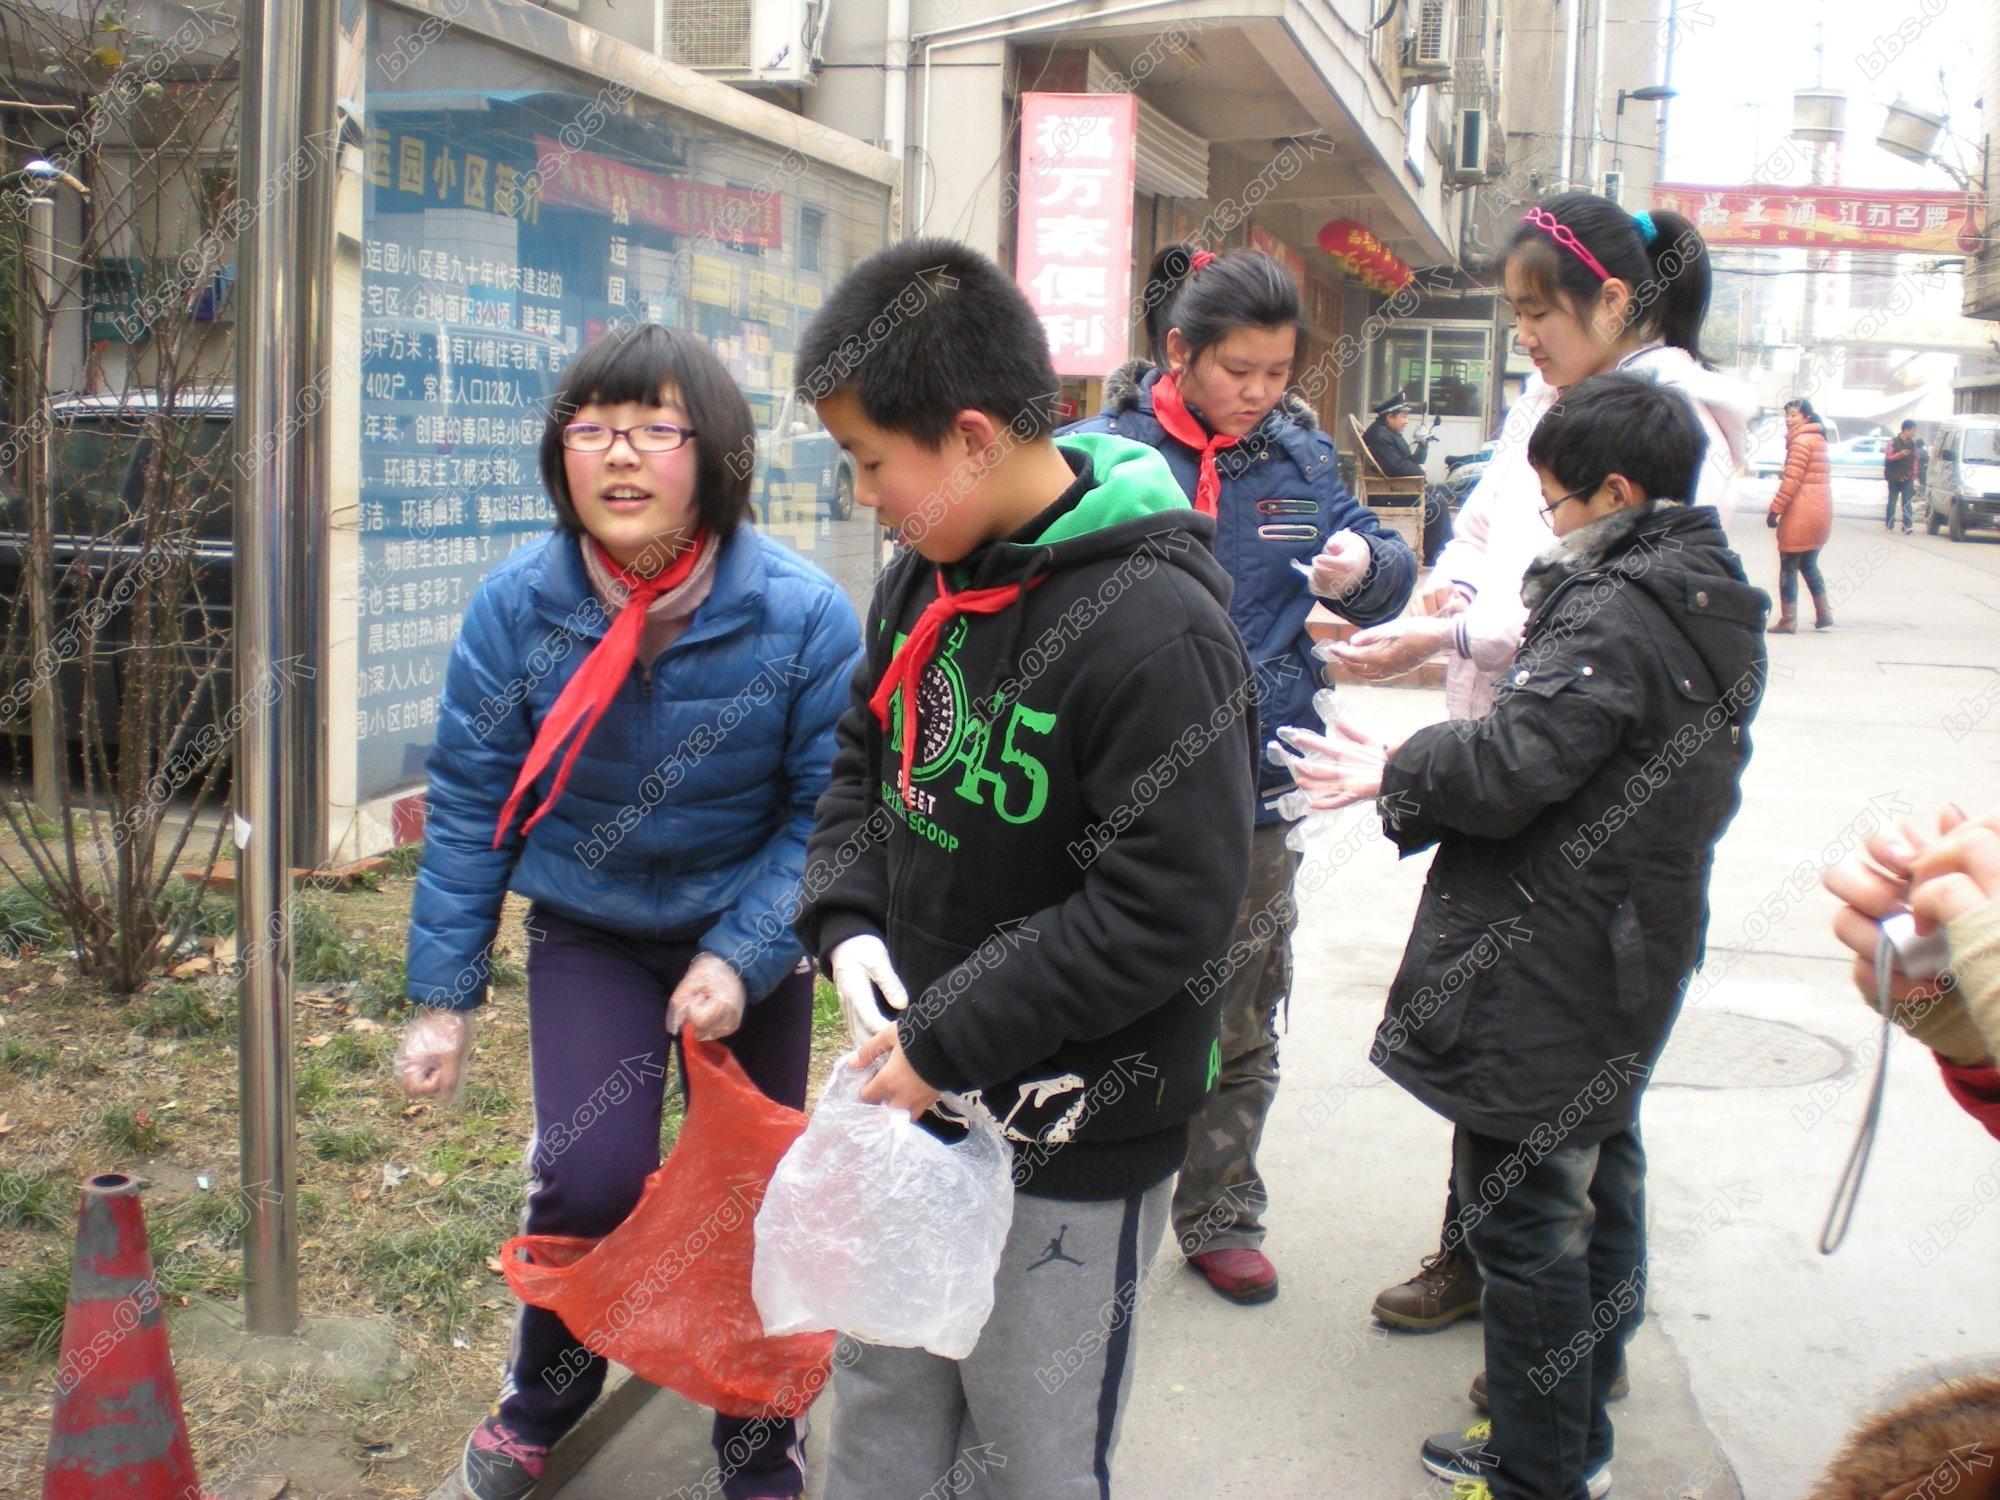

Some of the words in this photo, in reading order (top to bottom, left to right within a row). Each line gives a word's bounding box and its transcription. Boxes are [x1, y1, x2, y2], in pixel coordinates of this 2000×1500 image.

[1838, 200, 1951, 230] 江苏名牌
[361, 238, 562, 299] 运园小区是九十年代末建起的
[359, 372, 532, 407] 402户，常住人口1282人。
[359, 415, 545, 446] 年来，创建的春风给小区带
[896, 769, 936, 815] SEET
[908, 812, 959, 853] SCOOP
